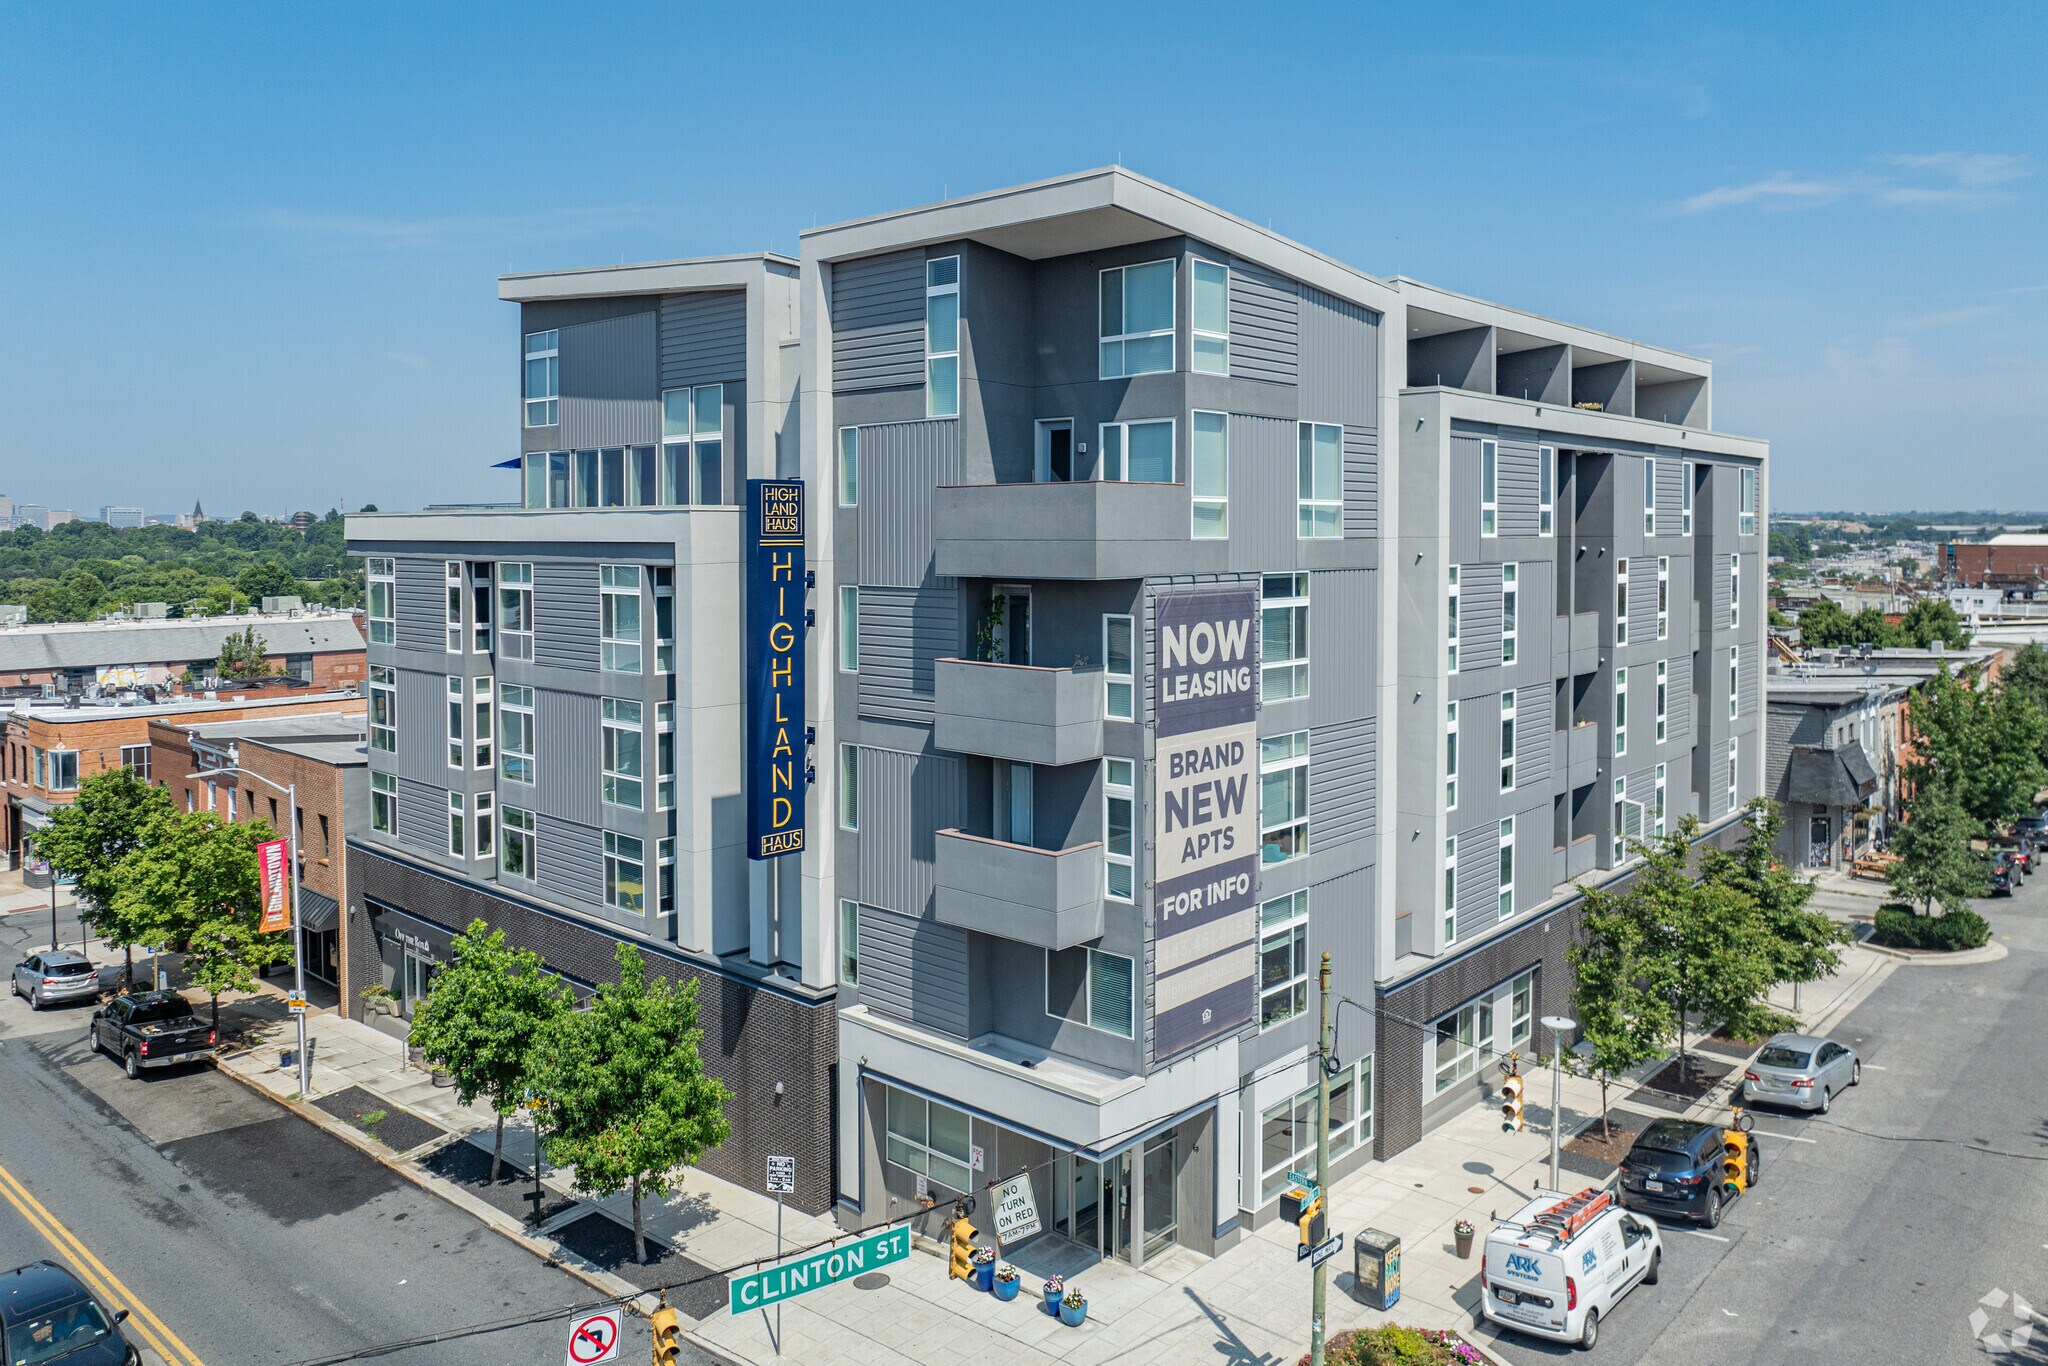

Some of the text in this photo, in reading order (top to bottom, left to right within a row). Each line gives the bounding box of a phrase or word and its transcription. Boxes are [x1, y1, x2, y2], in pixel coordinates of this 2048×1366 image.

[765, 488, 798, 501] HIGH
[765, 502, 798, 516] LAND
[767, 518, 797, 530] HAUS
[1162, 618, 1250, 669] NOW
[770, 552, 795, 828] HIGHLAND
[1162, 666, 1251, 703] LEASING
[1169, 741, 1245, 780] BRAND
[1164, 773, 1248, 833] NEW
[763, 831, 801, 853] HAUS
[1181, 825, 1235, 863] APTS
[1163, 872, 1250, 921] FOR INFO
[1002, 1184, 1018, 1198] NO
[1289, 1172, 1308, 1188] EASTERN
[1000, 1196, 1026, 1213] TURN
[998, 1207, 1034, 1228] ON RED
[1314, 1244, 1335, 1261] ONE WAY
[1582, 1247, 1598, 1271] ARK
[740, 1235, 903, 1305] CLINTON ST.
[1506, 1253, 1542, 1276] ARK
[1507, 1269, 1539, 1282] SYSTEMS
